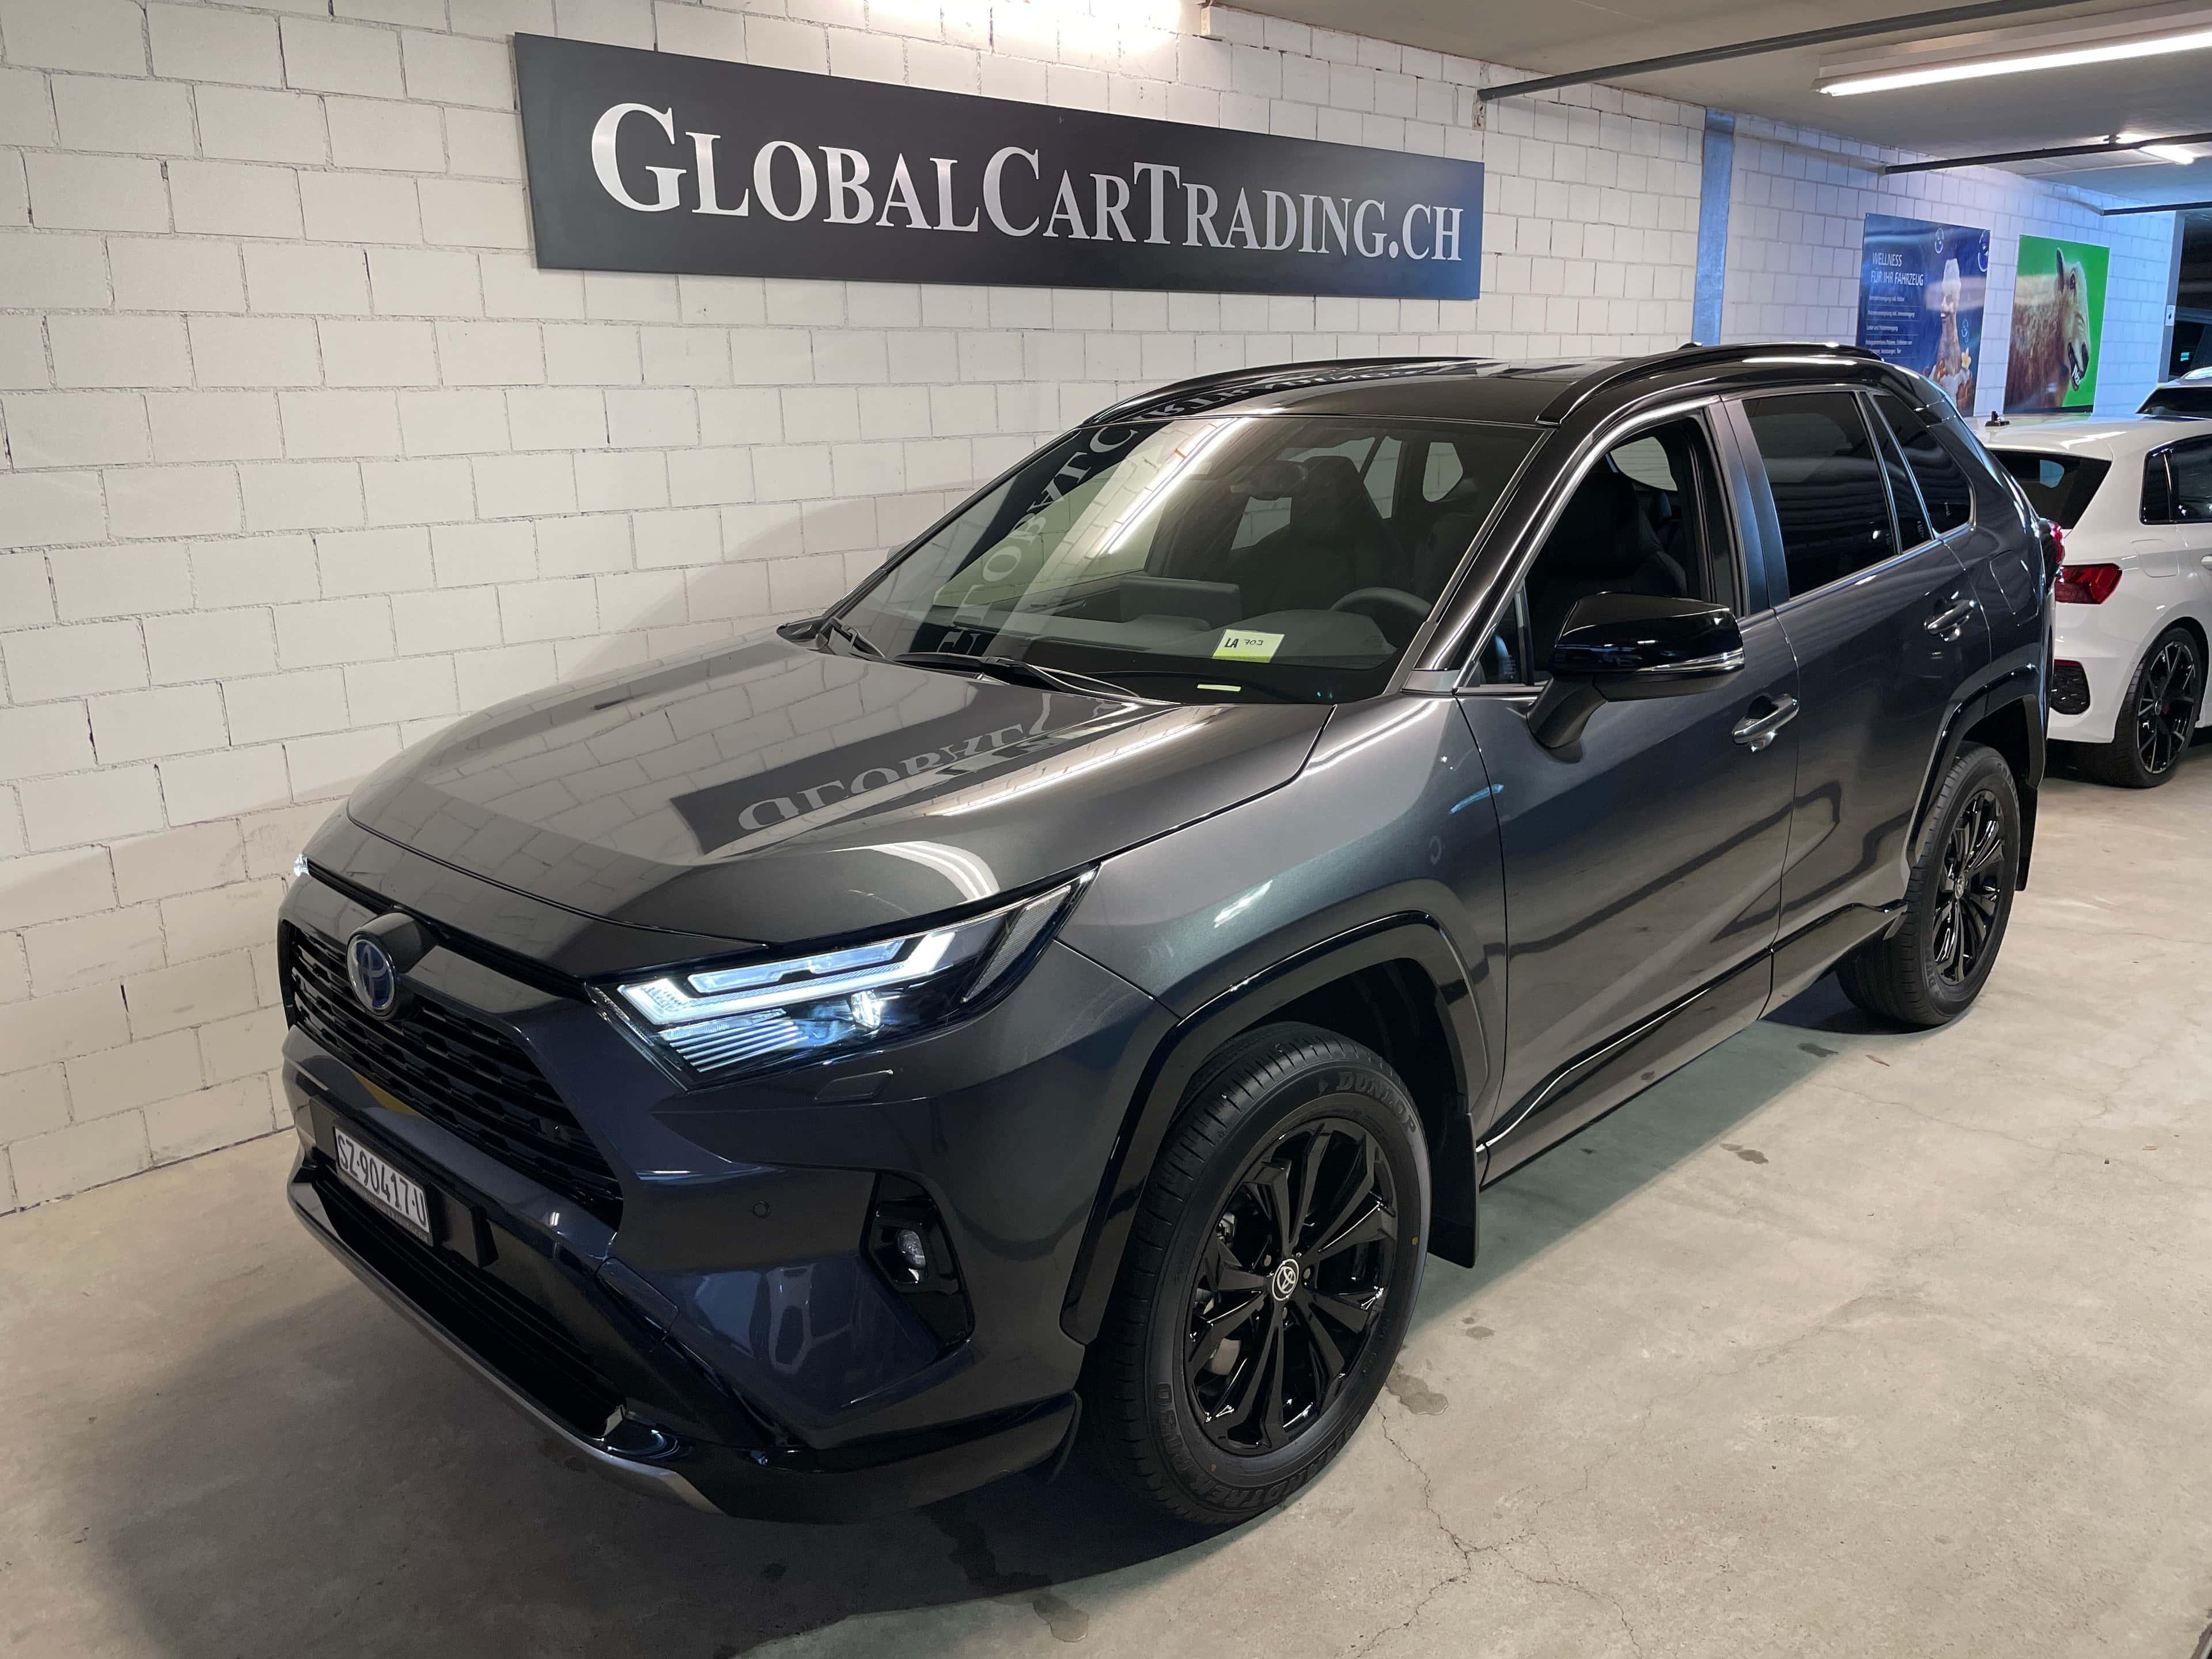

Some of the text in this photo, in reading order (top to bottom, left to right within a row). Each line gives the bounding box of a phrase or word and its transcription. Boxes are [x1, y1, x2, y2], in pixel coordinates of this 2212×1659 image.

[1872, 252, 1902, 267] WELLNESS
[1870, 267, 1924, 286] FÜR IHR FAHRZEUG
[1224, 638, 1240, 649] LA
